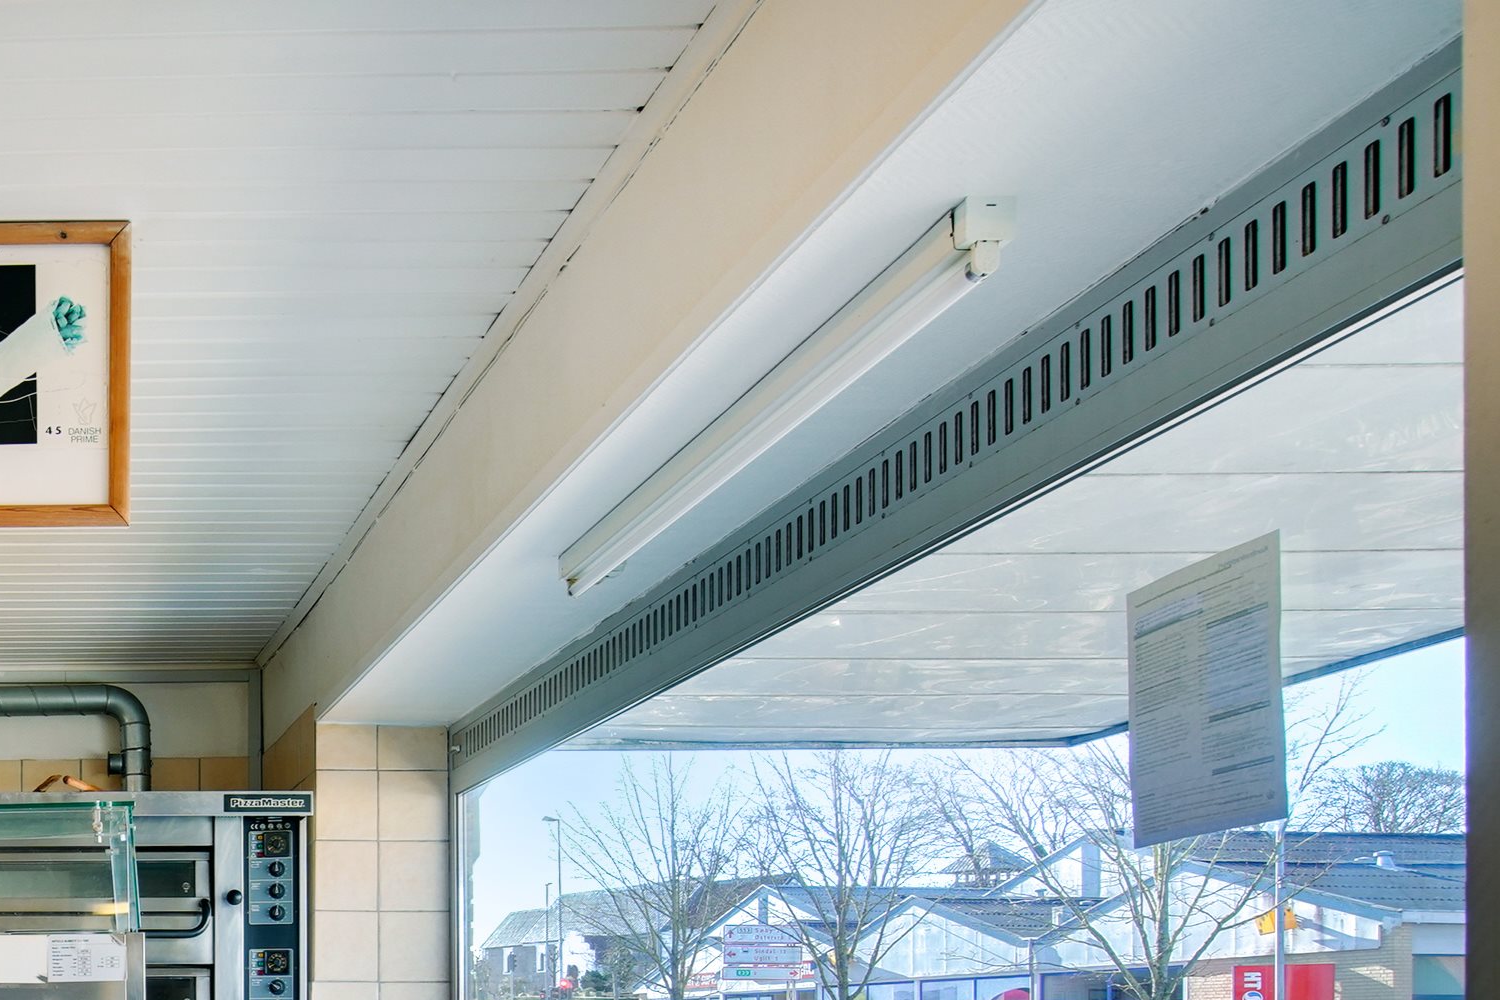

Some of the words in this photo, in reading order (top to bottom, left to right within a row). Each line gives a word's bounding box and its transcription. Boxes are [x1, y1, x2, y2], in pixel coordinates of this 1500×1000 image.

[68, 426, 102, 436] DANISH
[70, 435, 98, 443] PRIME
[230, 797, 305, 808] PizzaMaster
